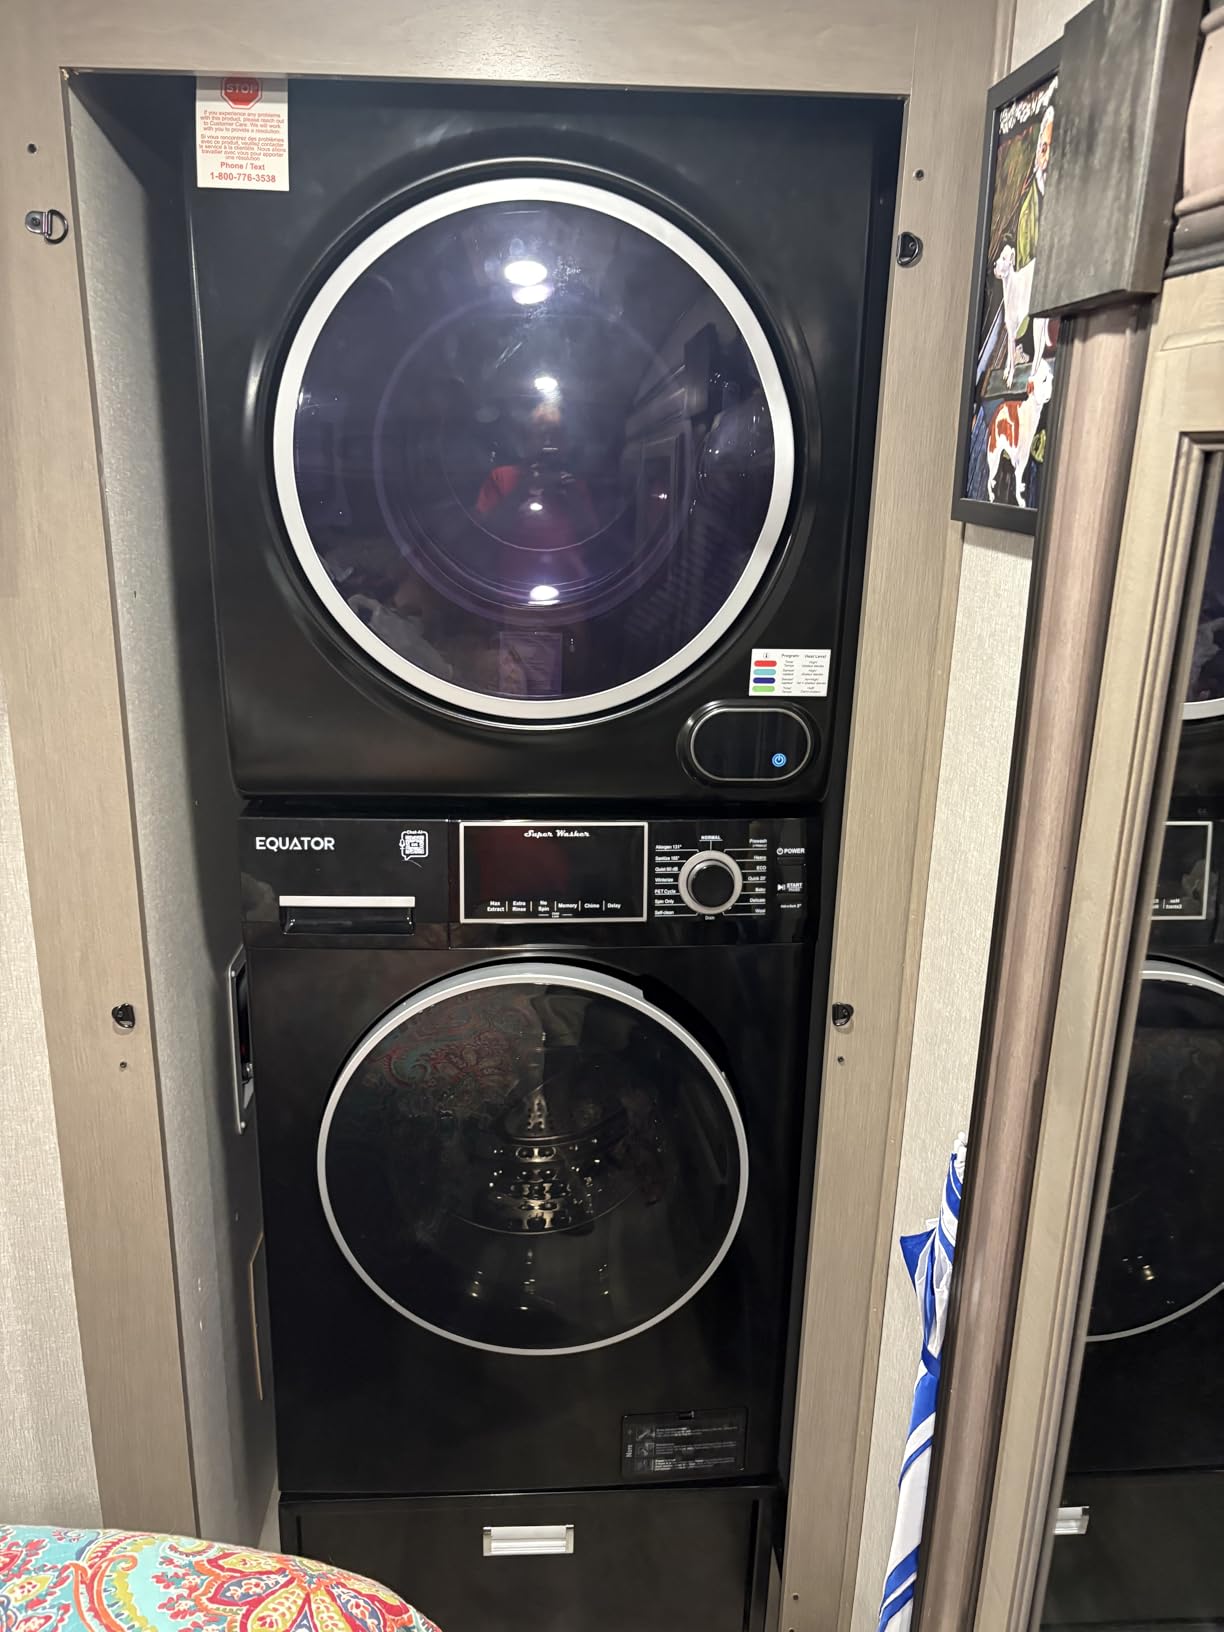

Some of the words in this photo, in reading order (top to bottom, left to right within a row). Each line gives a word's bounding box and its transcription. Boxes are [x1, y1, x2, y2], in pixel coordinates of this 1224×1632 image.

[210, 172, 276, 183] 1-800-776-3538
[523, 829, 553, 839] Super
[556, 829, 590, 838] Washer
[255, 836, 335, 852] EQUATOR
